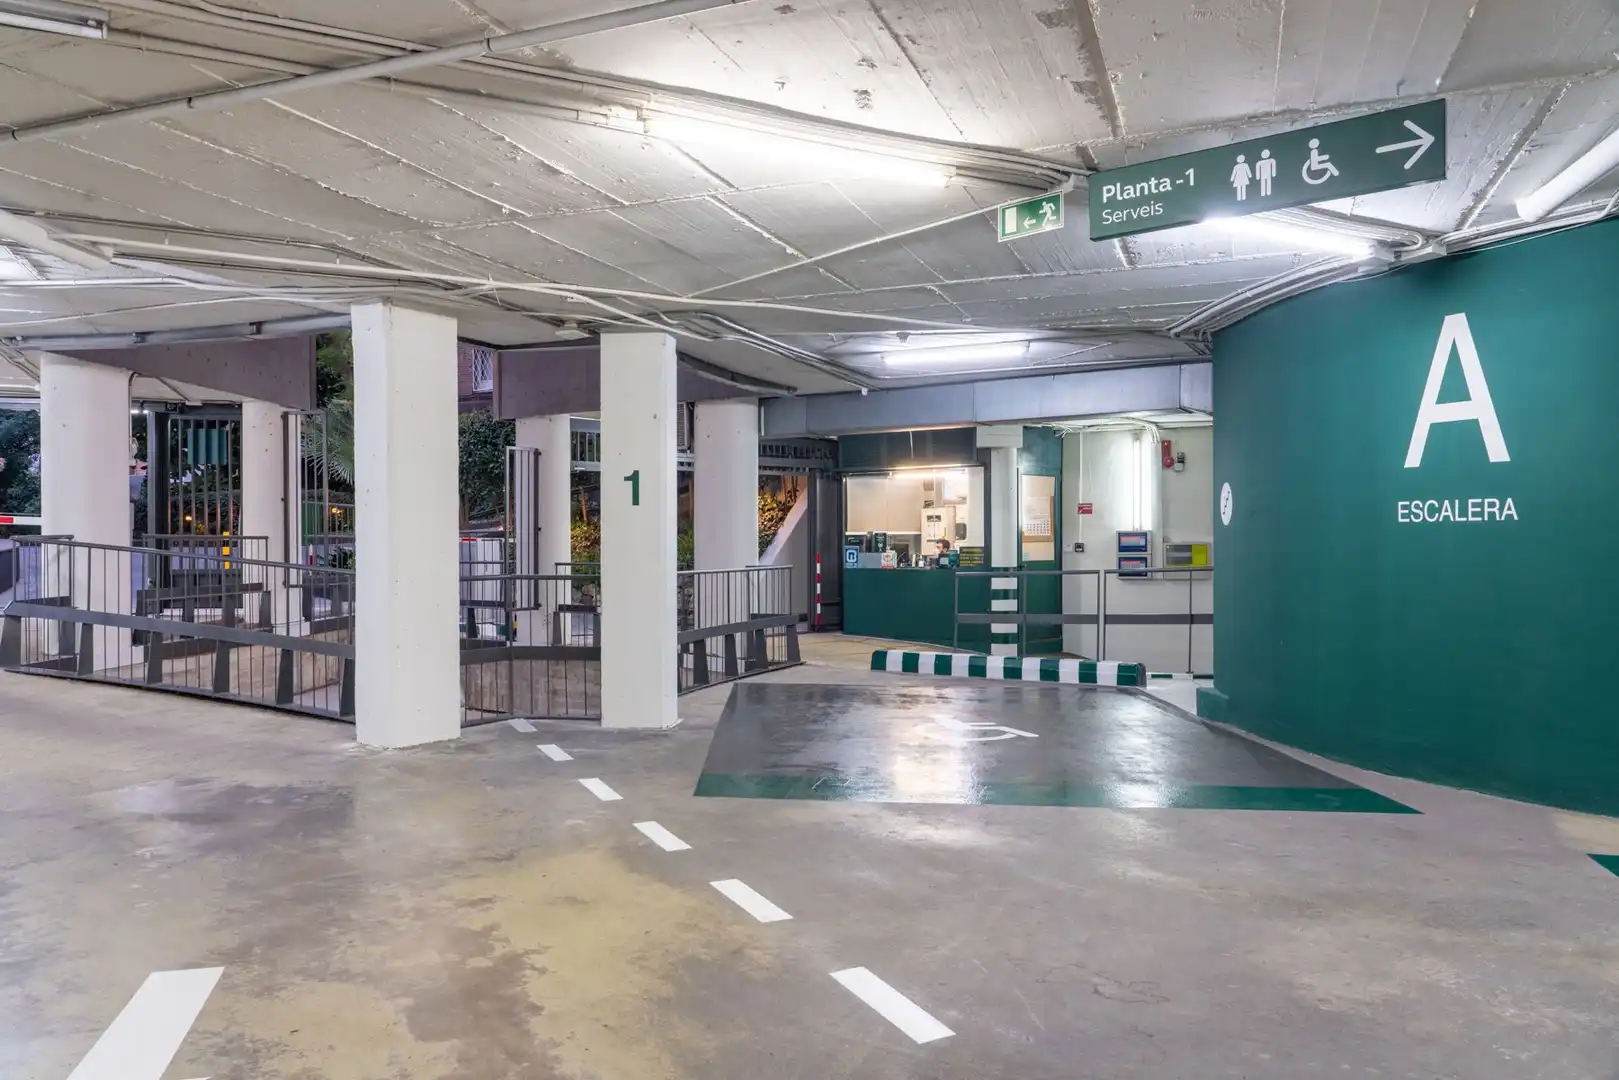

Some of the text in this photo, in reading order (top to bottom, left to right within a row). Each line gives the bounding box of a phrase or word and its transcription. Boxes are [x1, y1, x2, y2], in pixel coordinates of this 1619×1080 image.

[1102, 168, 1195, 203] Planta -1
[1102, 201, 1164, 224] Serveis
[1404, 313, 1511, 469] A
[623, 470, 640, 506] 1
[1397, 498, 1519, 524] ESCALERA
